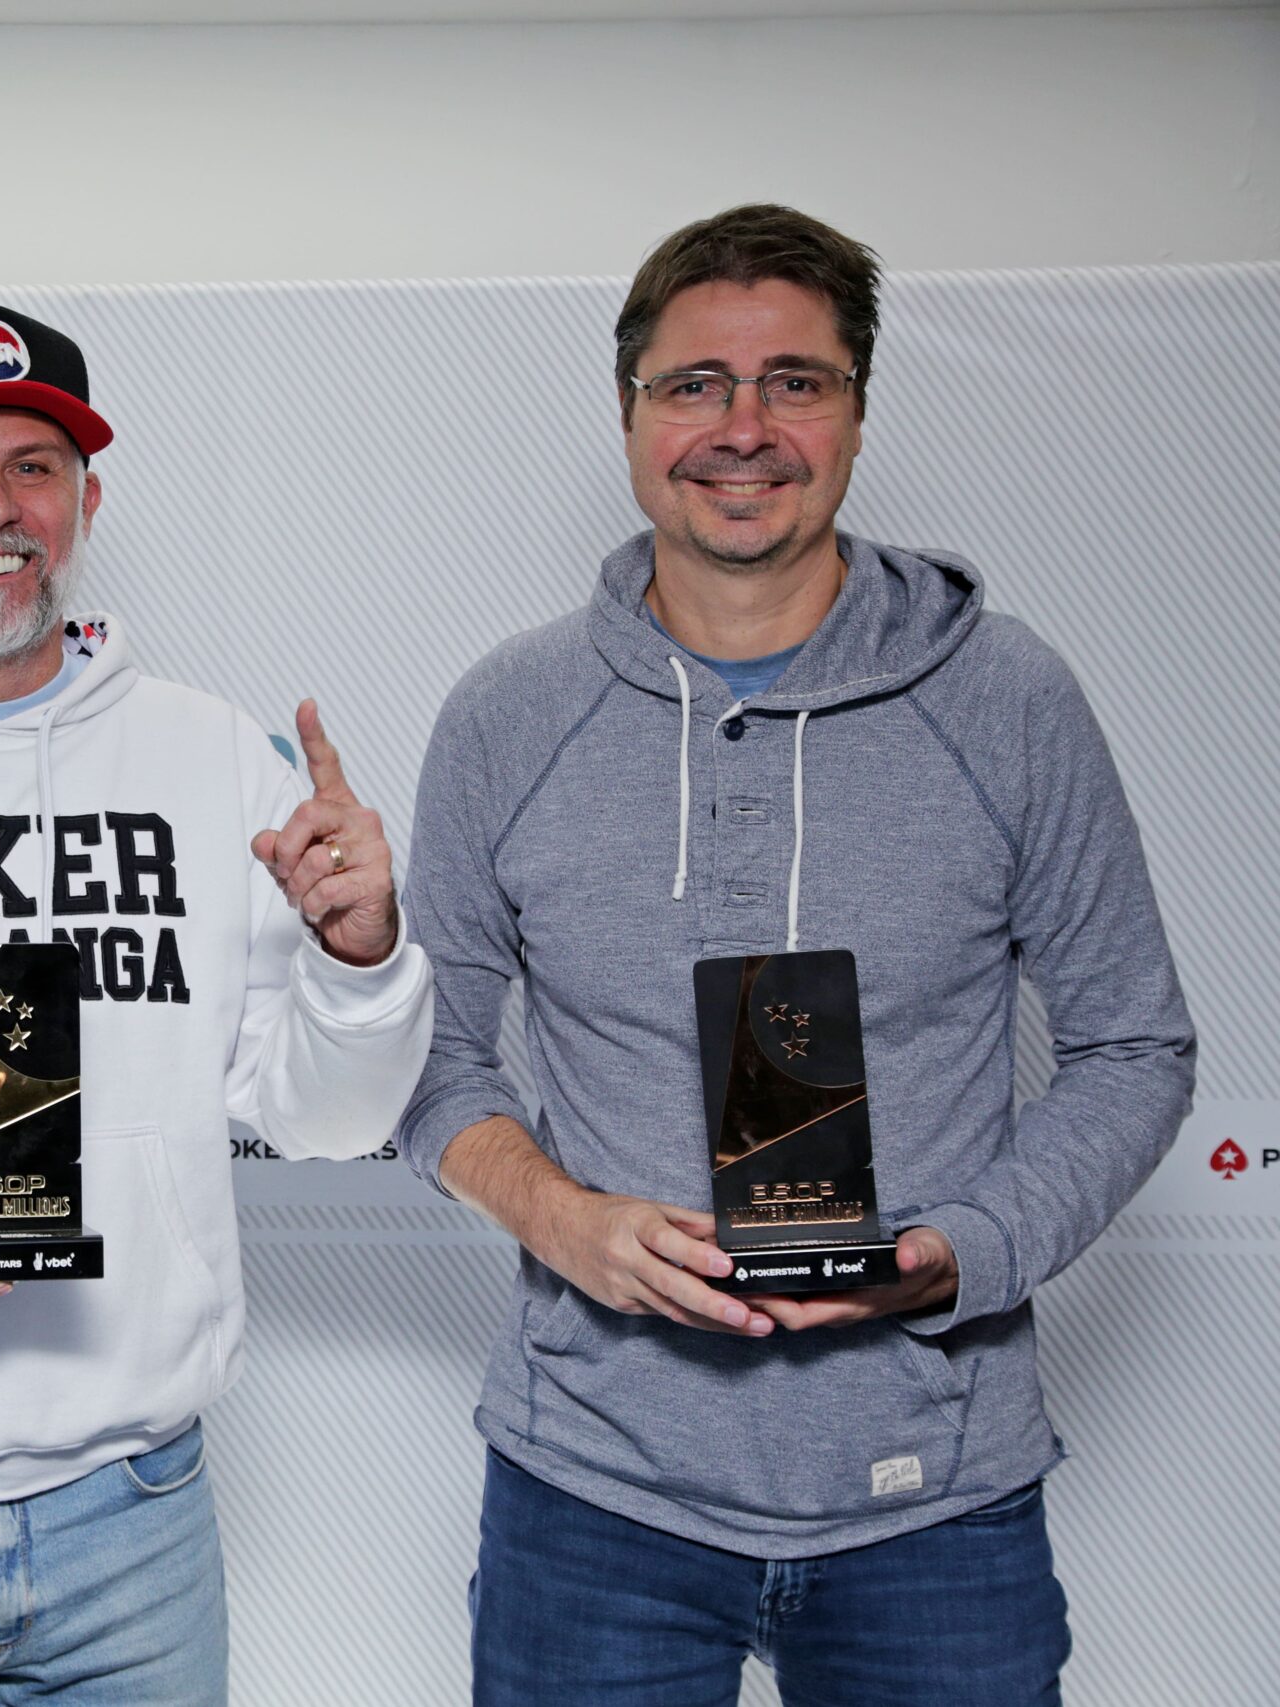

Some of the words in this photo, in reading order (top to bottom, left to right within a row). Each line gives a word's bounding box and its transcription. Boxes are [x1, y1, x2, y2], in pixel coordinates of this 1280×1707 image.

[750, 1180, 836, 1204] BSOP
[2, 1195, 71, 1218] MILLIONS
[726, 1205, 786, 1229] WINTER
[794, 1201, 865, 1224] MILLIONS
[45, 1254, 73, 1268] vbet
[749, 1266, 812, 1278] POKERSTARS
[834, 1260, 864, 1275] vbet
